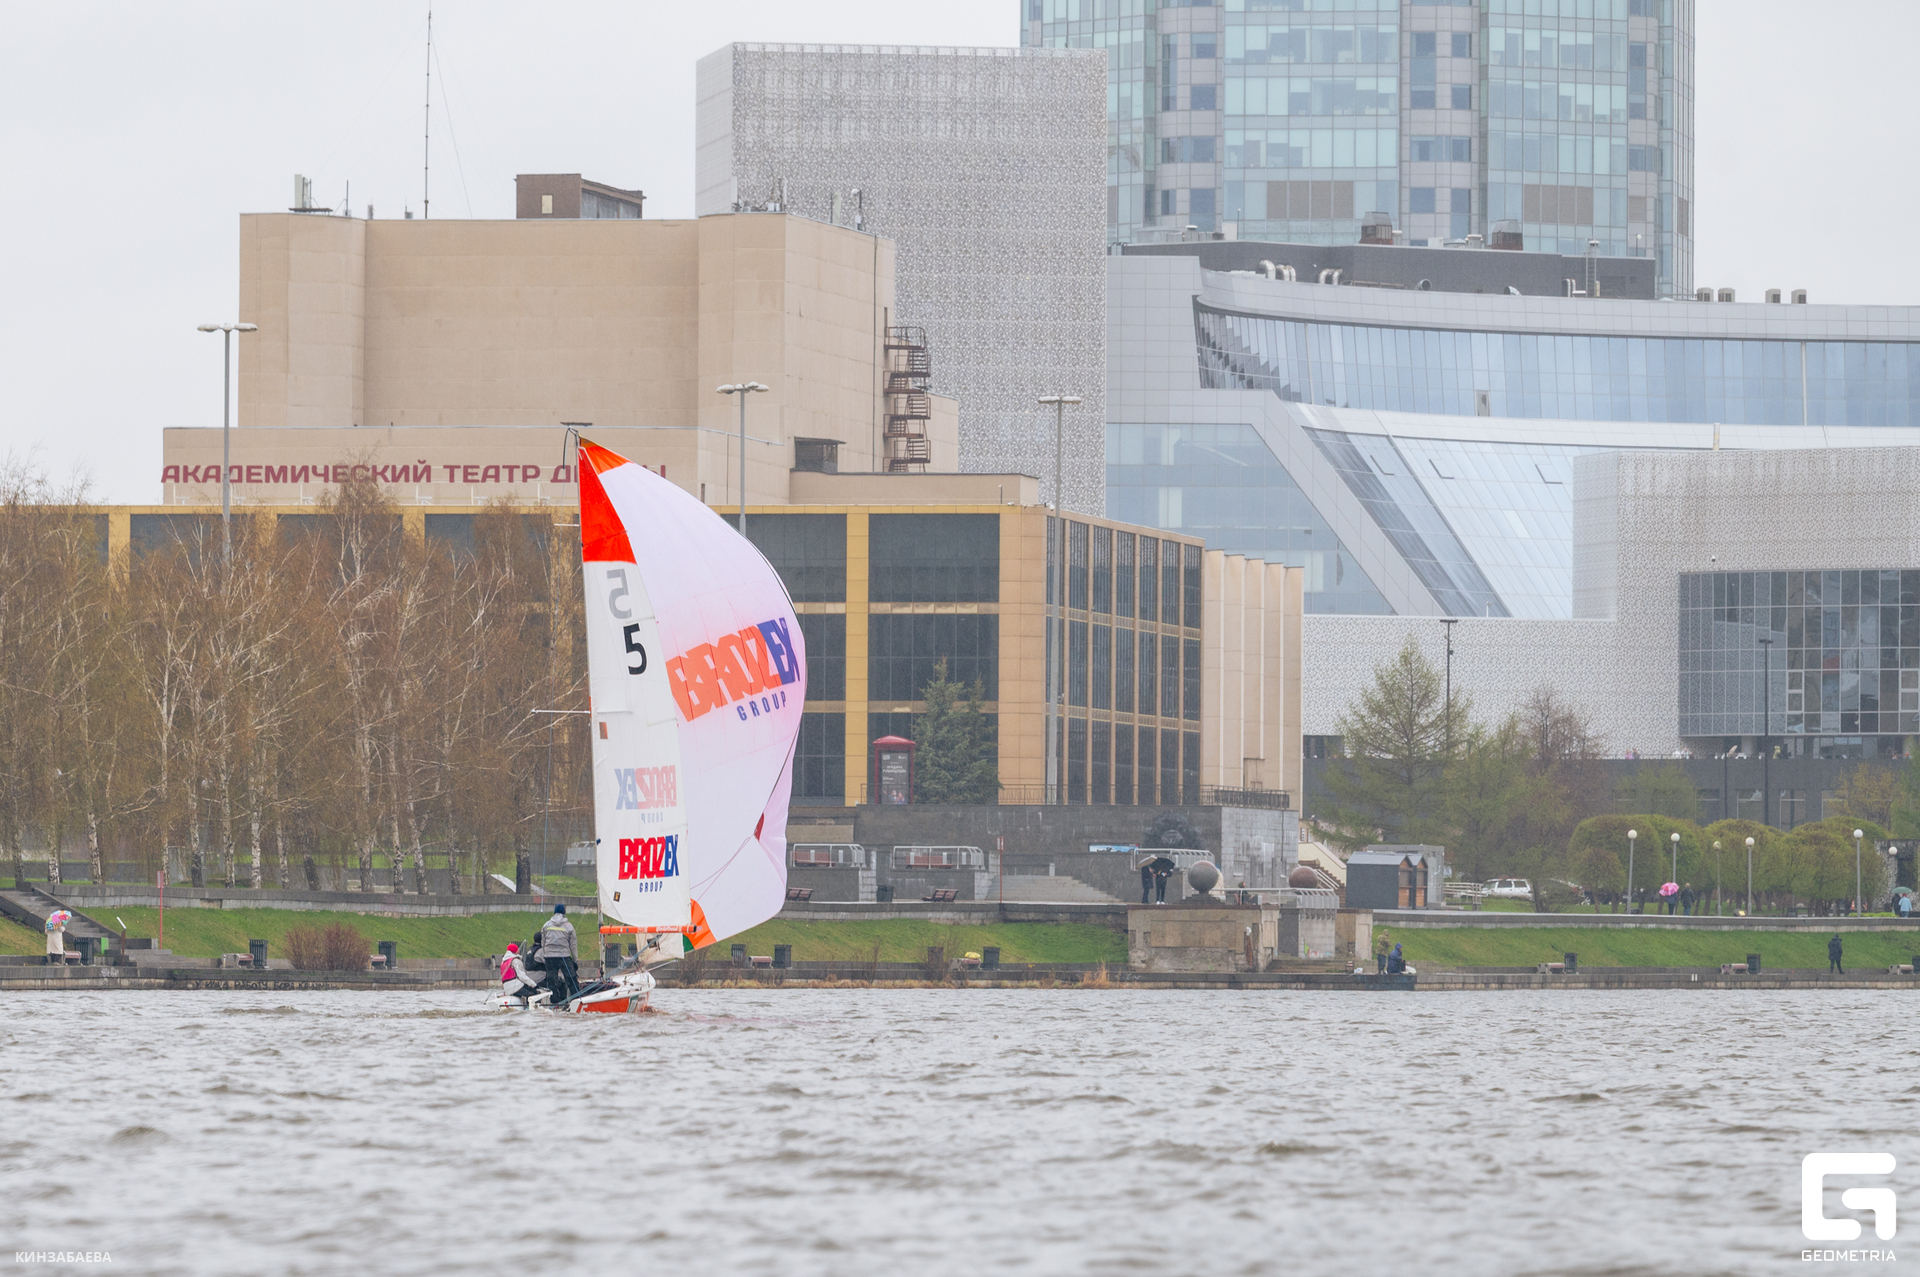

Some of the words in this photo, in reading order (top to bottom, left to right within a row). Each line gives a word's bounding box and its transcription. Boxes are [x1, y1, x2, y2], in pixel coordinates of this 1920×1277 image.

[161, 459, 432, 483] АКАДЕМИЧЕСКИЙ
[443, 465, 540, 483] ТЕАТР
[622, 623, 648, 675] 5
[737, 691, 787, 721] GROUP
[618, 834, 680, 880] BROZEX
[639, 881, 663, 893] GROUP
